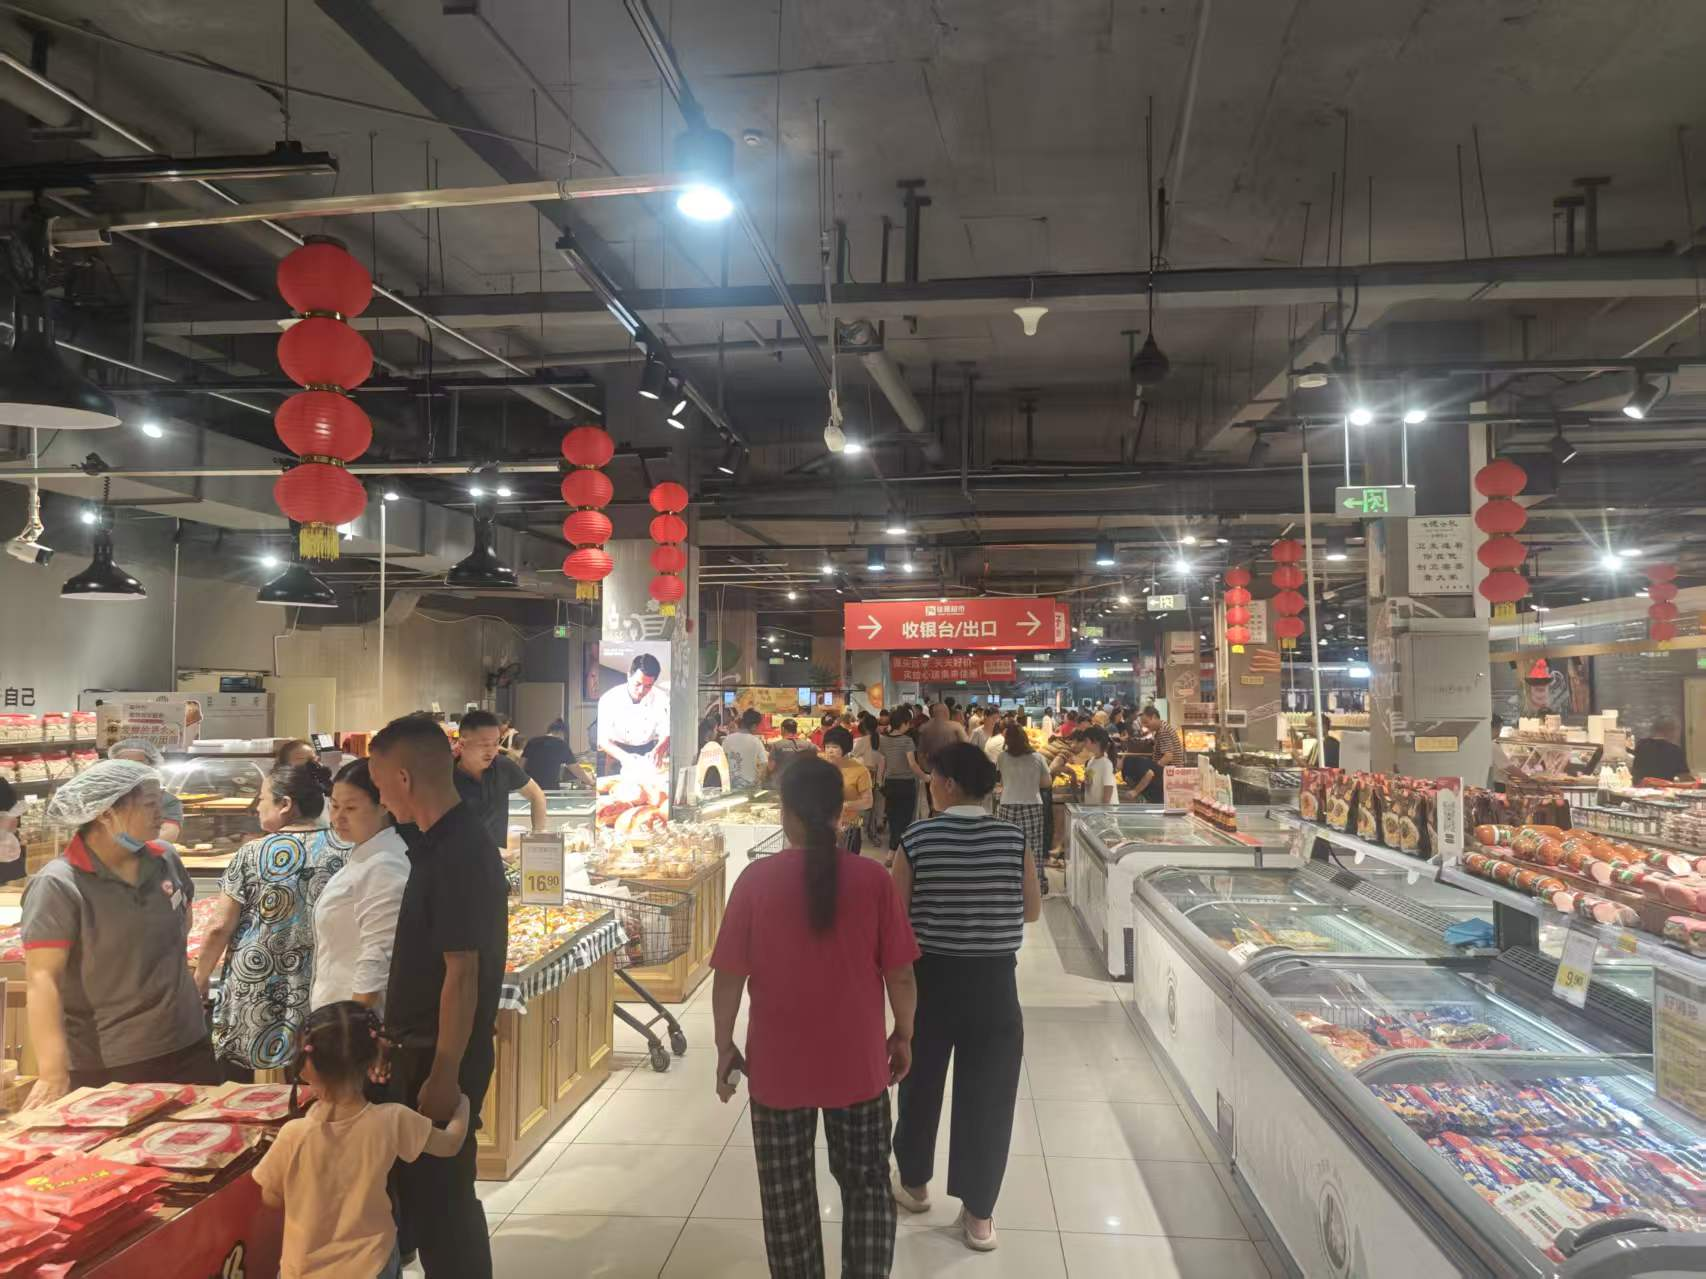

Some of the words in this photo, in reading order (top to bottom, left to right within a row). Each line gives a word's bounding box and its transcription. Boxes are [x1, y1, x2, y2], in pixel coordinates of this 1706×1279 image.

[902, 620, 997, 639] 收银台/出口
[0, 686, 36, 707] 自己
